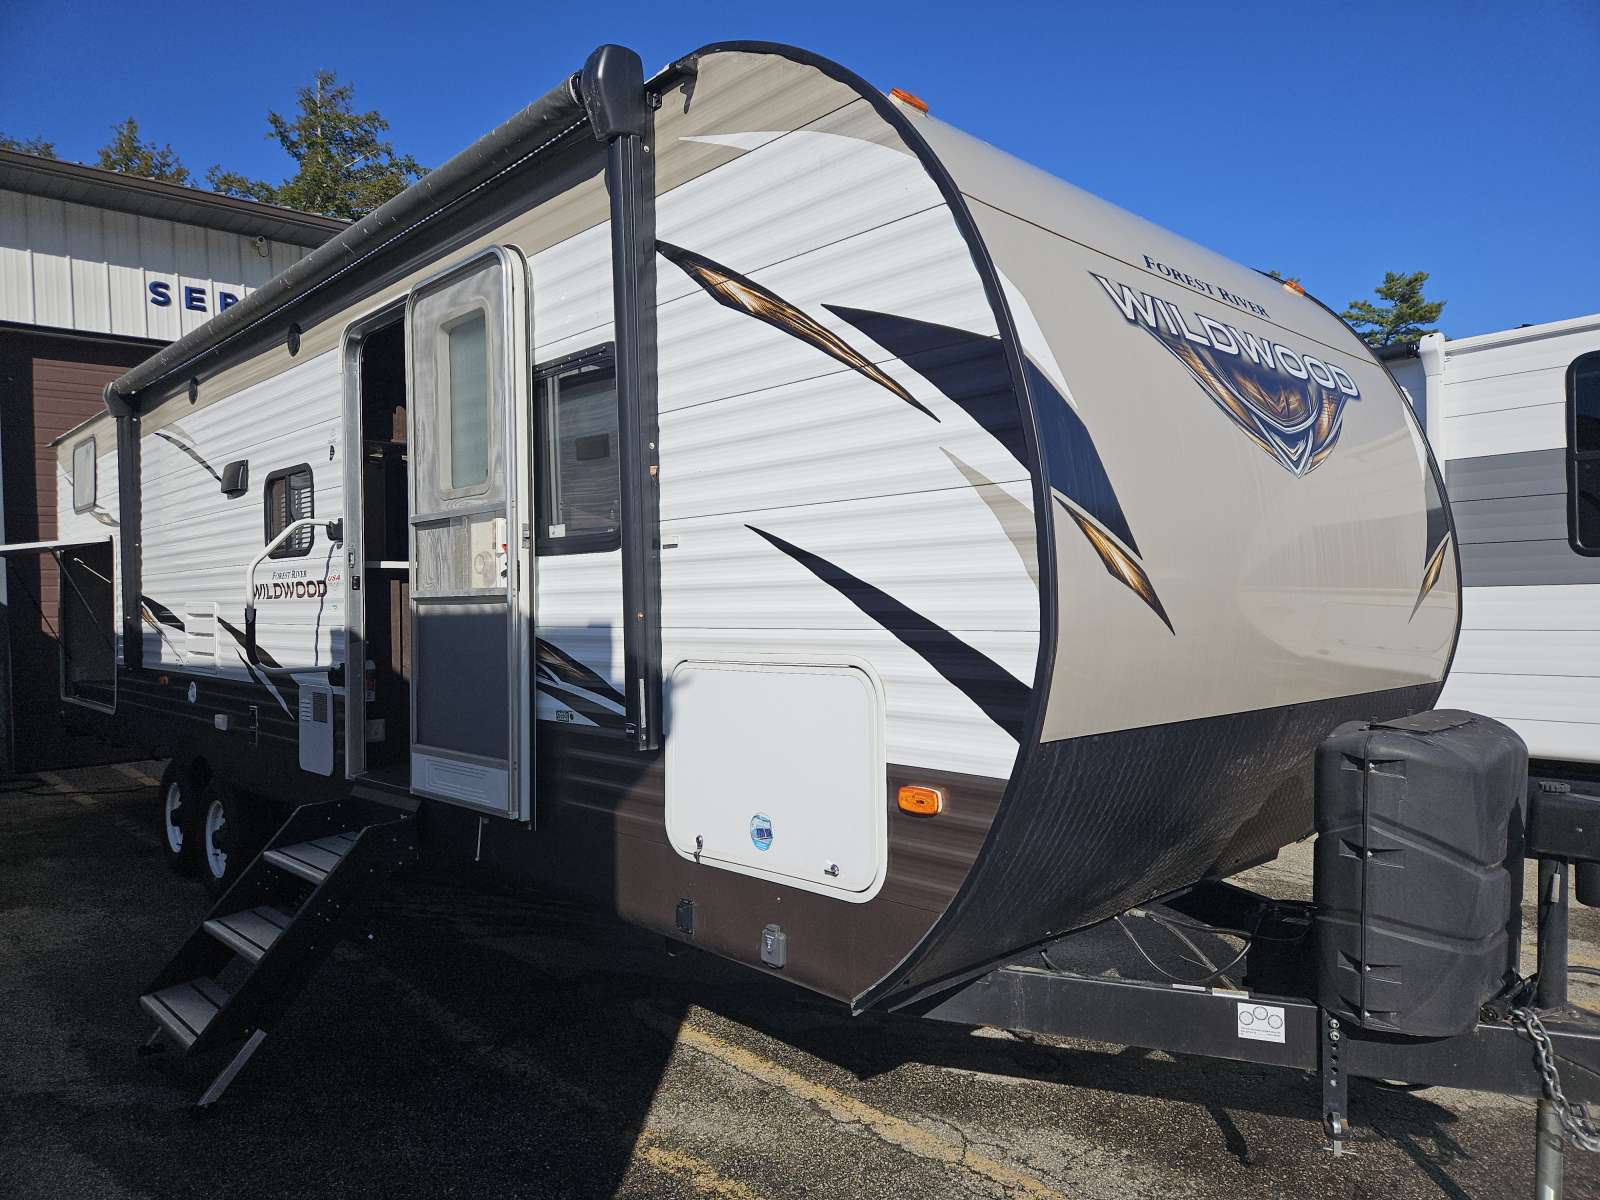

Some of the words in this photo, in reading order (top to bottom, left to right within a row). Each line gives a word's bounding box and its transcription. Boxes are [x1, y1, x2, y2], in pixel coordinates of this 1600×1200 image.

[1142, 254, 1214, 295] FOREST
[1217, 286, 1271, 320] RIVER
[1088, 270, 1361, 400] WILDWOOD
[253, 580, 328, 600] WILDWOOD
[272, 571, 291, 580] FOREST
[291, 570, 307, 579] RIVER
